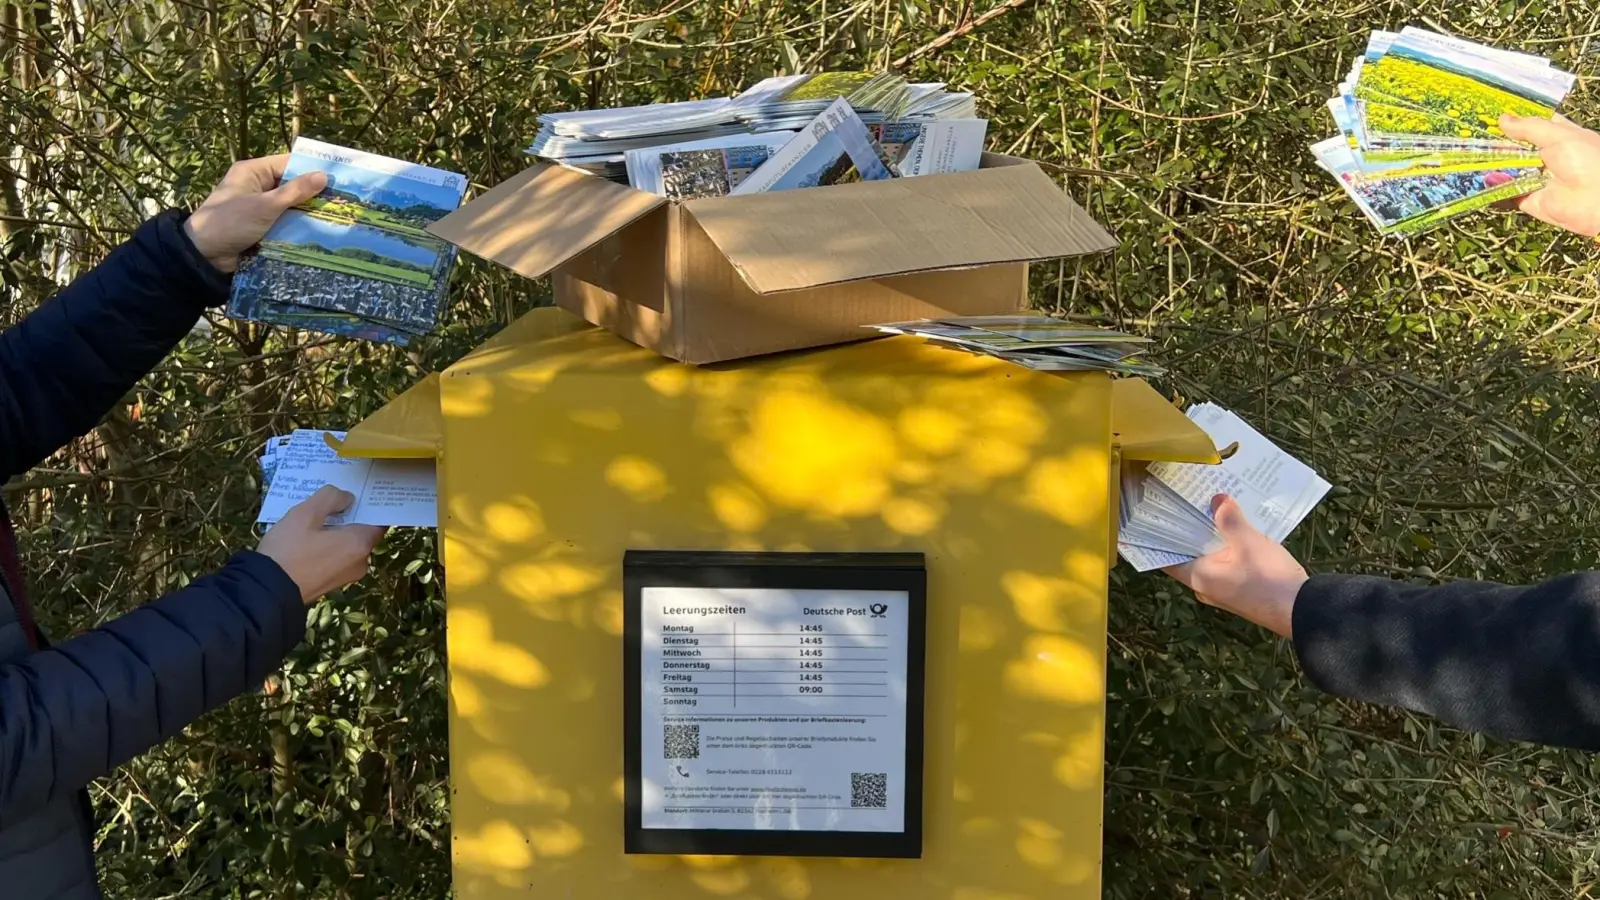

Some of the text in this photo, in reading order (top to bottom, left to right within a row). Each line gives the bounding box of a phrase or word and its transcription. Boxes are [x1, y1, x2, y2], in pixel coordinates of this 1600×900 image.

[663, 605, 746, 616] Leerungszeiten
[803, 607, 867, 616] Deutsche Post
[663, 625, 694, 633] Montag
[663, 637, 699, 645] Dienstag
[663, 649, 823, 657] Mittwoch 14:45
[663, 661, 823, 670] Donnerstag 14:45
[663, 673, 692, 682] Freitag
[663, 686, 699, 694] Samstag
[663, 698, 697, 706] Sonntag
